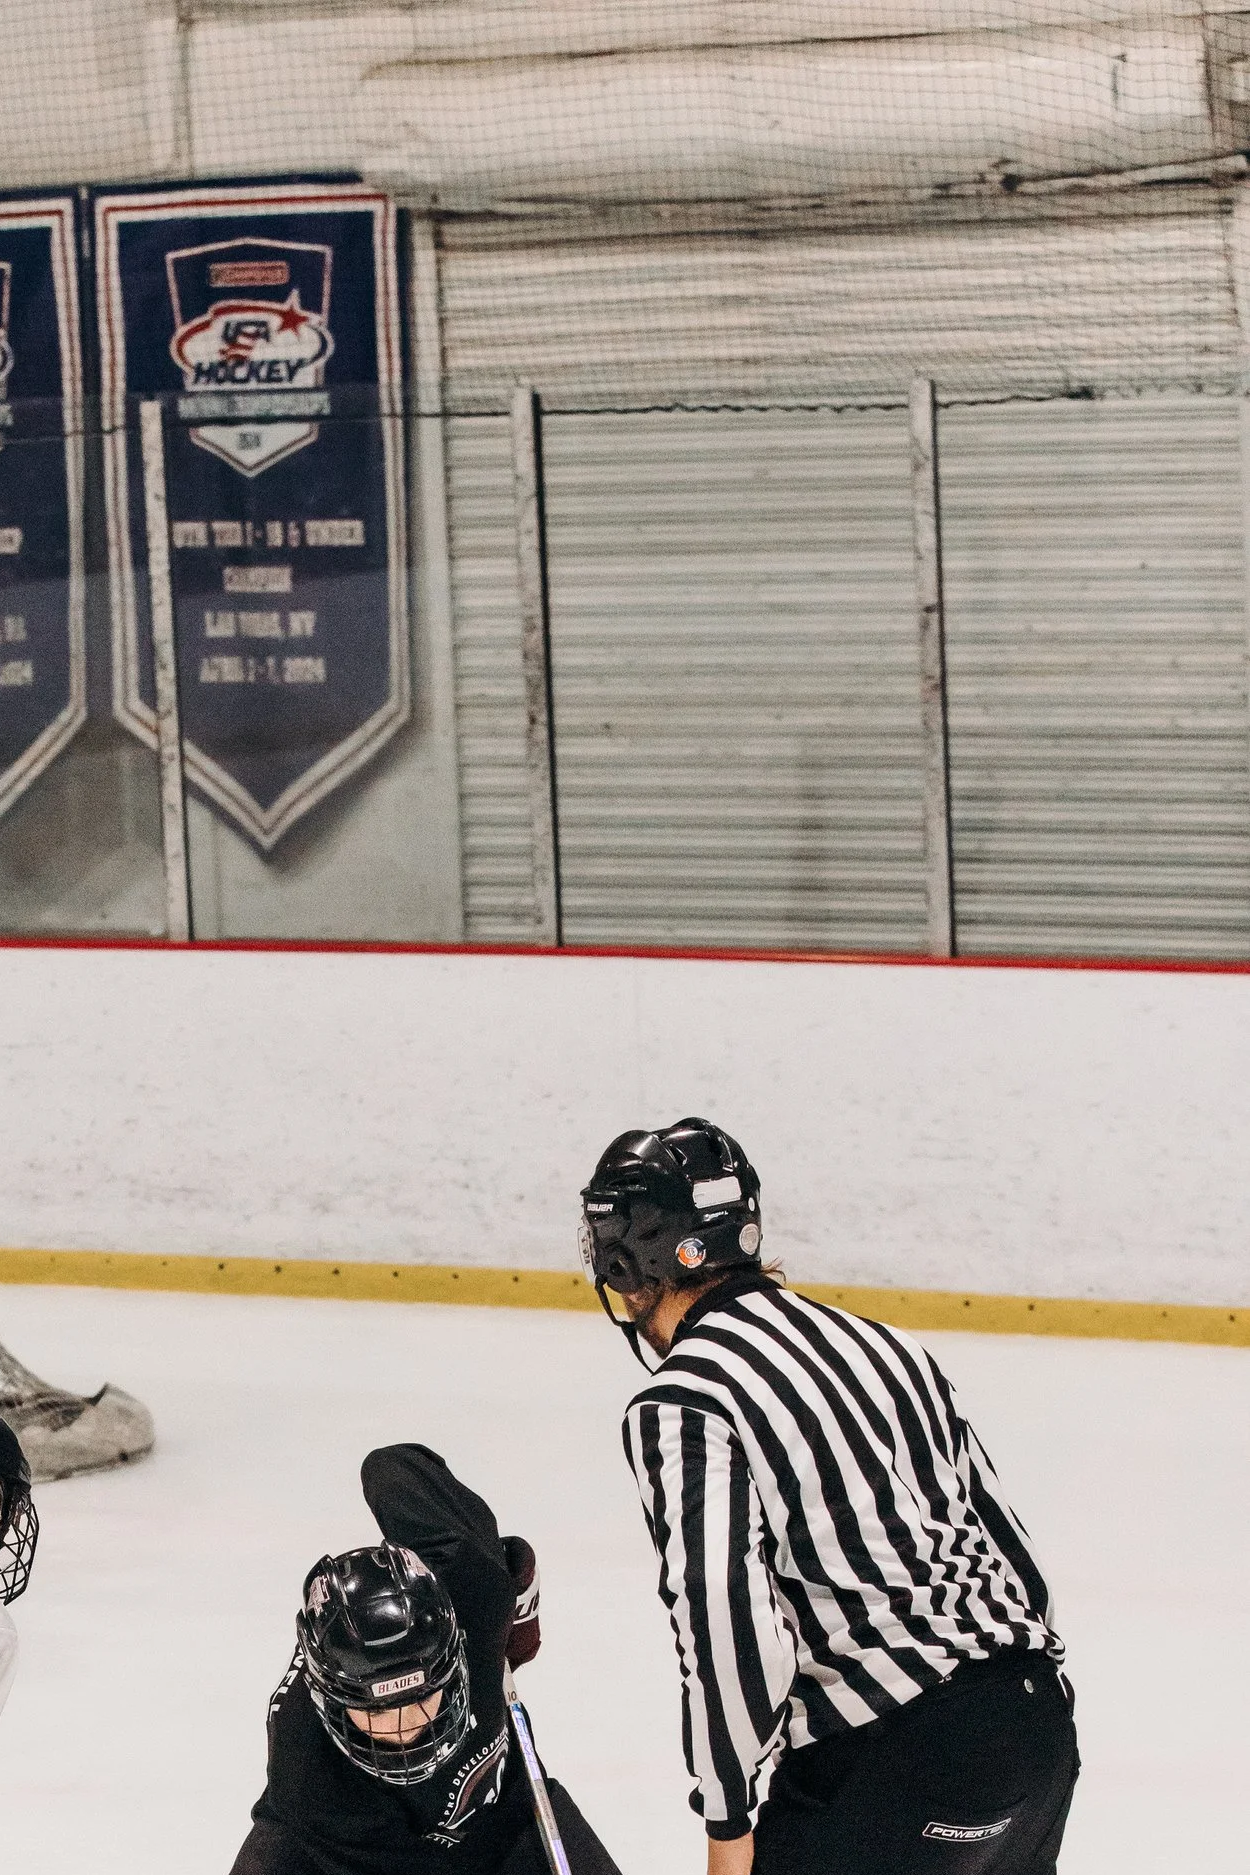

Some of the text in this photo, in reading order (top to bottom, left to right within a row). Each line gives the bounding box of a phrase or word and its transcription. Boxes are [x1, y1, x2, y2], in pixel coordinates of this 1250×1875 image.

[194, 358, 303, 385] HOCKEY
[377, 1675, 421, 1695] BLADES
[443, 1792, 456, 1816] PRO
[931, 1823, 1007, 1838] POWERTEK
